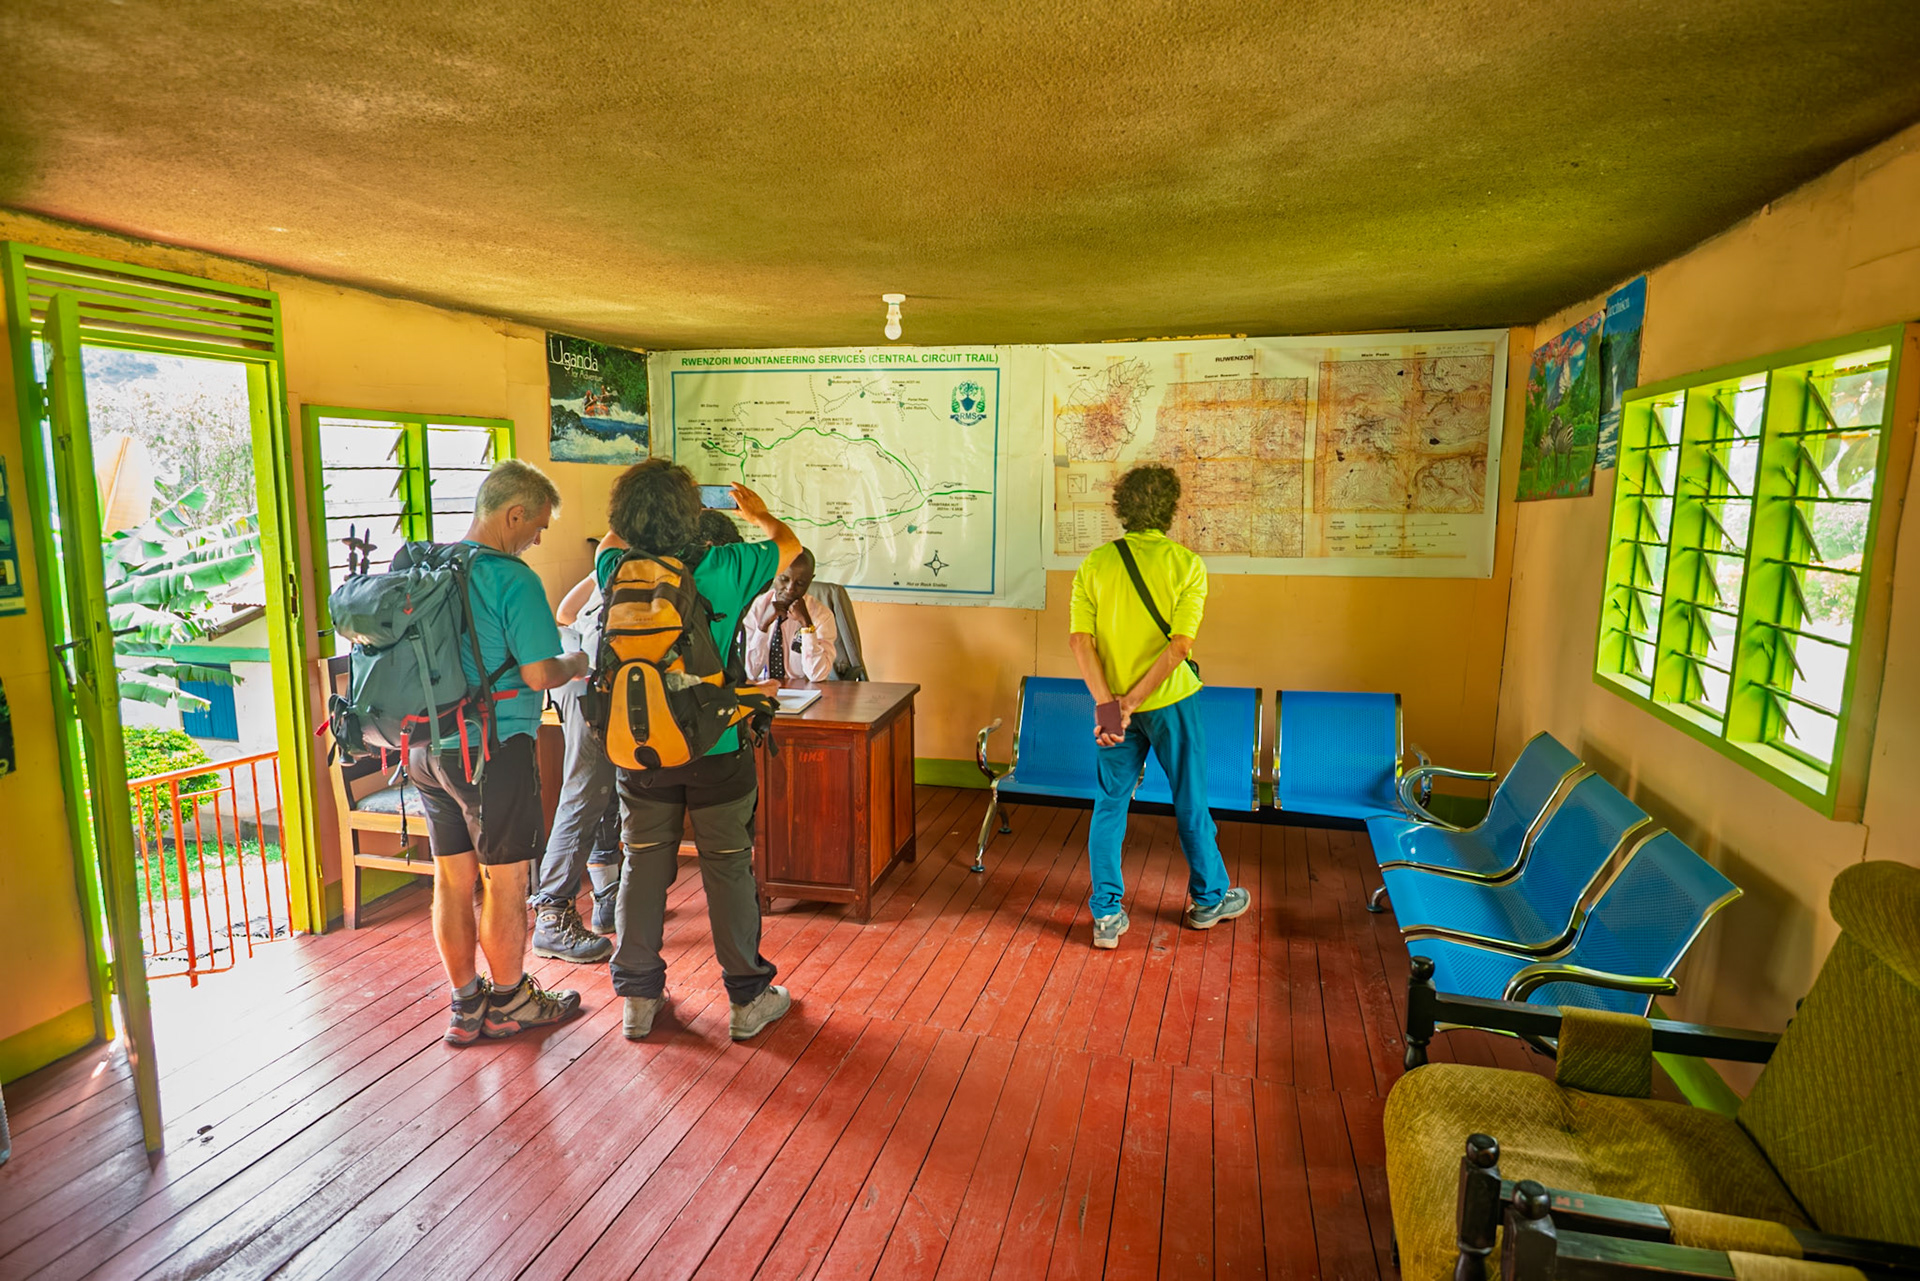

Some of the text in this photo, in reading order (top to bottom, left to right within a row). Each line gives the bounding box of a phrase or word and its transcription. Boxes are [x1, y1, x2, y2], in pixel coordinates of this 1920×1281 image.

[549, 338, 599, 371] Uganda
[682, 353, 999, 367] RWENZORI MOUNTANEERING SERVICES (CENTRAL CIRCUIT TRAIL)
[960, 412, 977, 420] RMS
